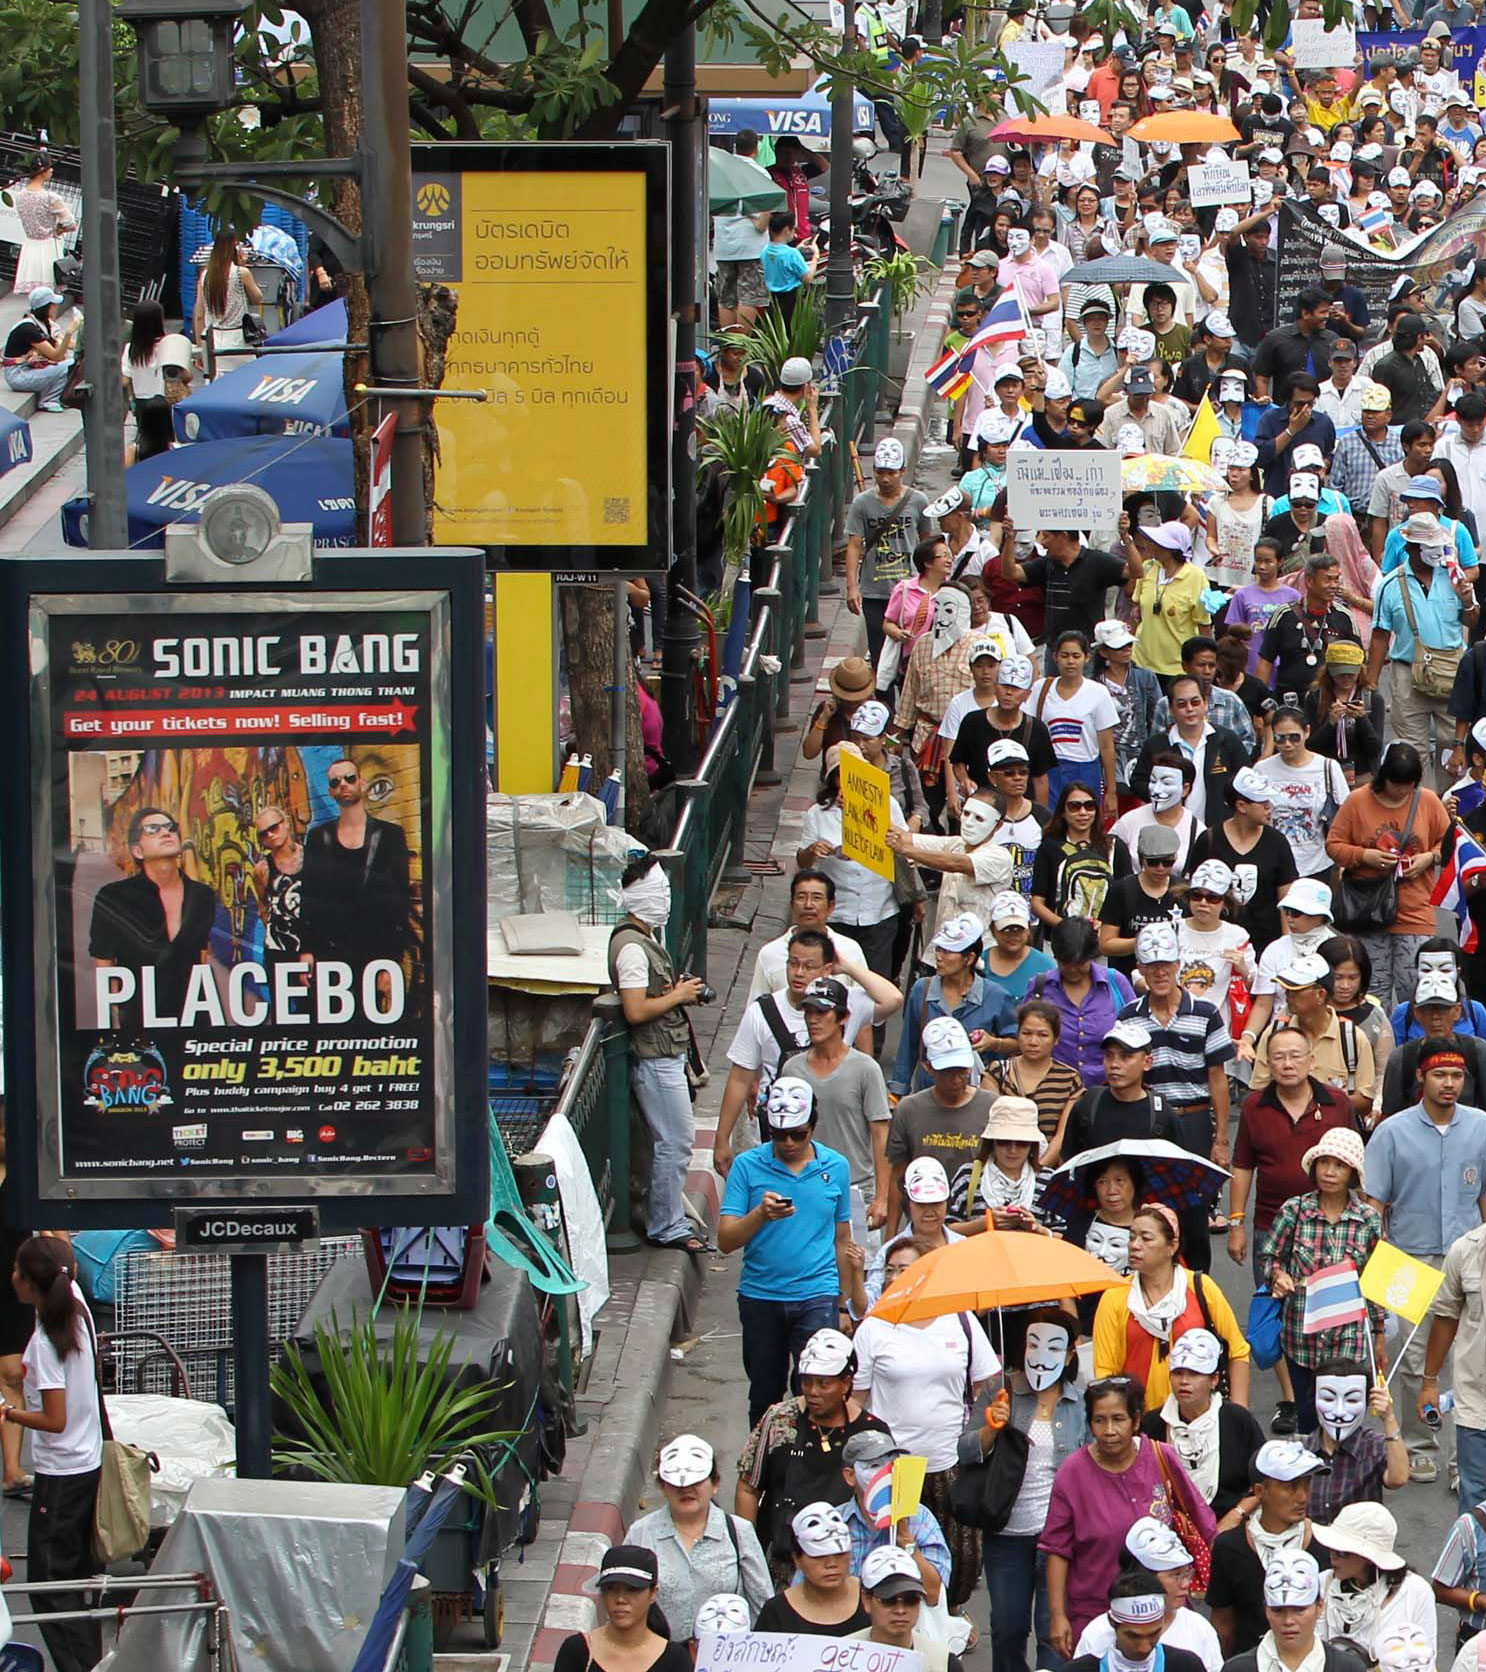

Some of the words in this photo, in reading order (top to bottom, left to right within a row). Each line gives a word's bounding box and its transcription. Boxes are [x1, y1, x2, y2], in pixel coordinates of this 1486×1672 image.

[765, 110, 822, 133] VISA
[412, 220, 455, 231] krungsri
[475, 219, 570, 239] บัตรเดบิต
[475, 246, 629, 270] ออมทรัพย์จัดให้
[248, 377, 318, 404] VISA
[515, 391, 525, 404] 5
[531, 388, 556, 405] บิล
[562, 386, 628, 408] ทุกเดือน
[556, 574, 584, 582] RAJ-W
[588, 574, 597, 582] 11
[153, 635, 283, 679] SONIC
[299, 633, 420, 675] BANG
[73, 688, 98, 702] 24
[104, 687, 174, 702] AUGUST
[178, 687, 224, 701] 2013
[229, 689, 277, 699] IMPACT
[281, 688, 328, 698] MUANG
[330, 687, 374, 697] THONG
[377, 686, 416, 696] THANI
[70, 718, 102, 733] Get
[111, 718, 153, 736] your
[162, 715, 228, 731] tickets
[235, 713, 281, 730] now!
[289, 713, 352, 731] Selling
[359, 711, 403, 727] fast!
[847, 771, 884, 807] AMNESTY
[95, 959, 406, 1030] PLACEBO
[184, 1038, 253, 1055] Special
[260, 1039, 308, 1054] price
[316, 1037, 418, 1053] promotion
[182, 1058, 248, 1083] only
[257, 1057, 342, 1081] 3,500
[352, 1056, 421, 1077] baht
[100, 1082, 158, 1108] BANG
[185, 1086, 210, 1096] Plus
[213, 1086, 250, 1097] buddy
[253, 1084, 310, 1096] campaign
[314, 1084, 336, 1095] buy
[339, 1084, 348, 1094] 4
[352, 1084, 371, 1095] get
[389, 1082, 420, 1092] FREE!
[333, 1101, 351, 1111] 02
[355, 1101, 381, 1110] 262
[385, 1100, 419, 1110] 3838
[174, 1126, 208, 1138] TICKET
[75, 1158, 175, 1168] www.sonicbang.net
[200, 1221, 297, 1236] JCDecaux
[1131, 1597, 1160, 1614] กู้ชาติ
[820, 1645, 864, 1671] get
[867, 1652, 905, 1672] out
